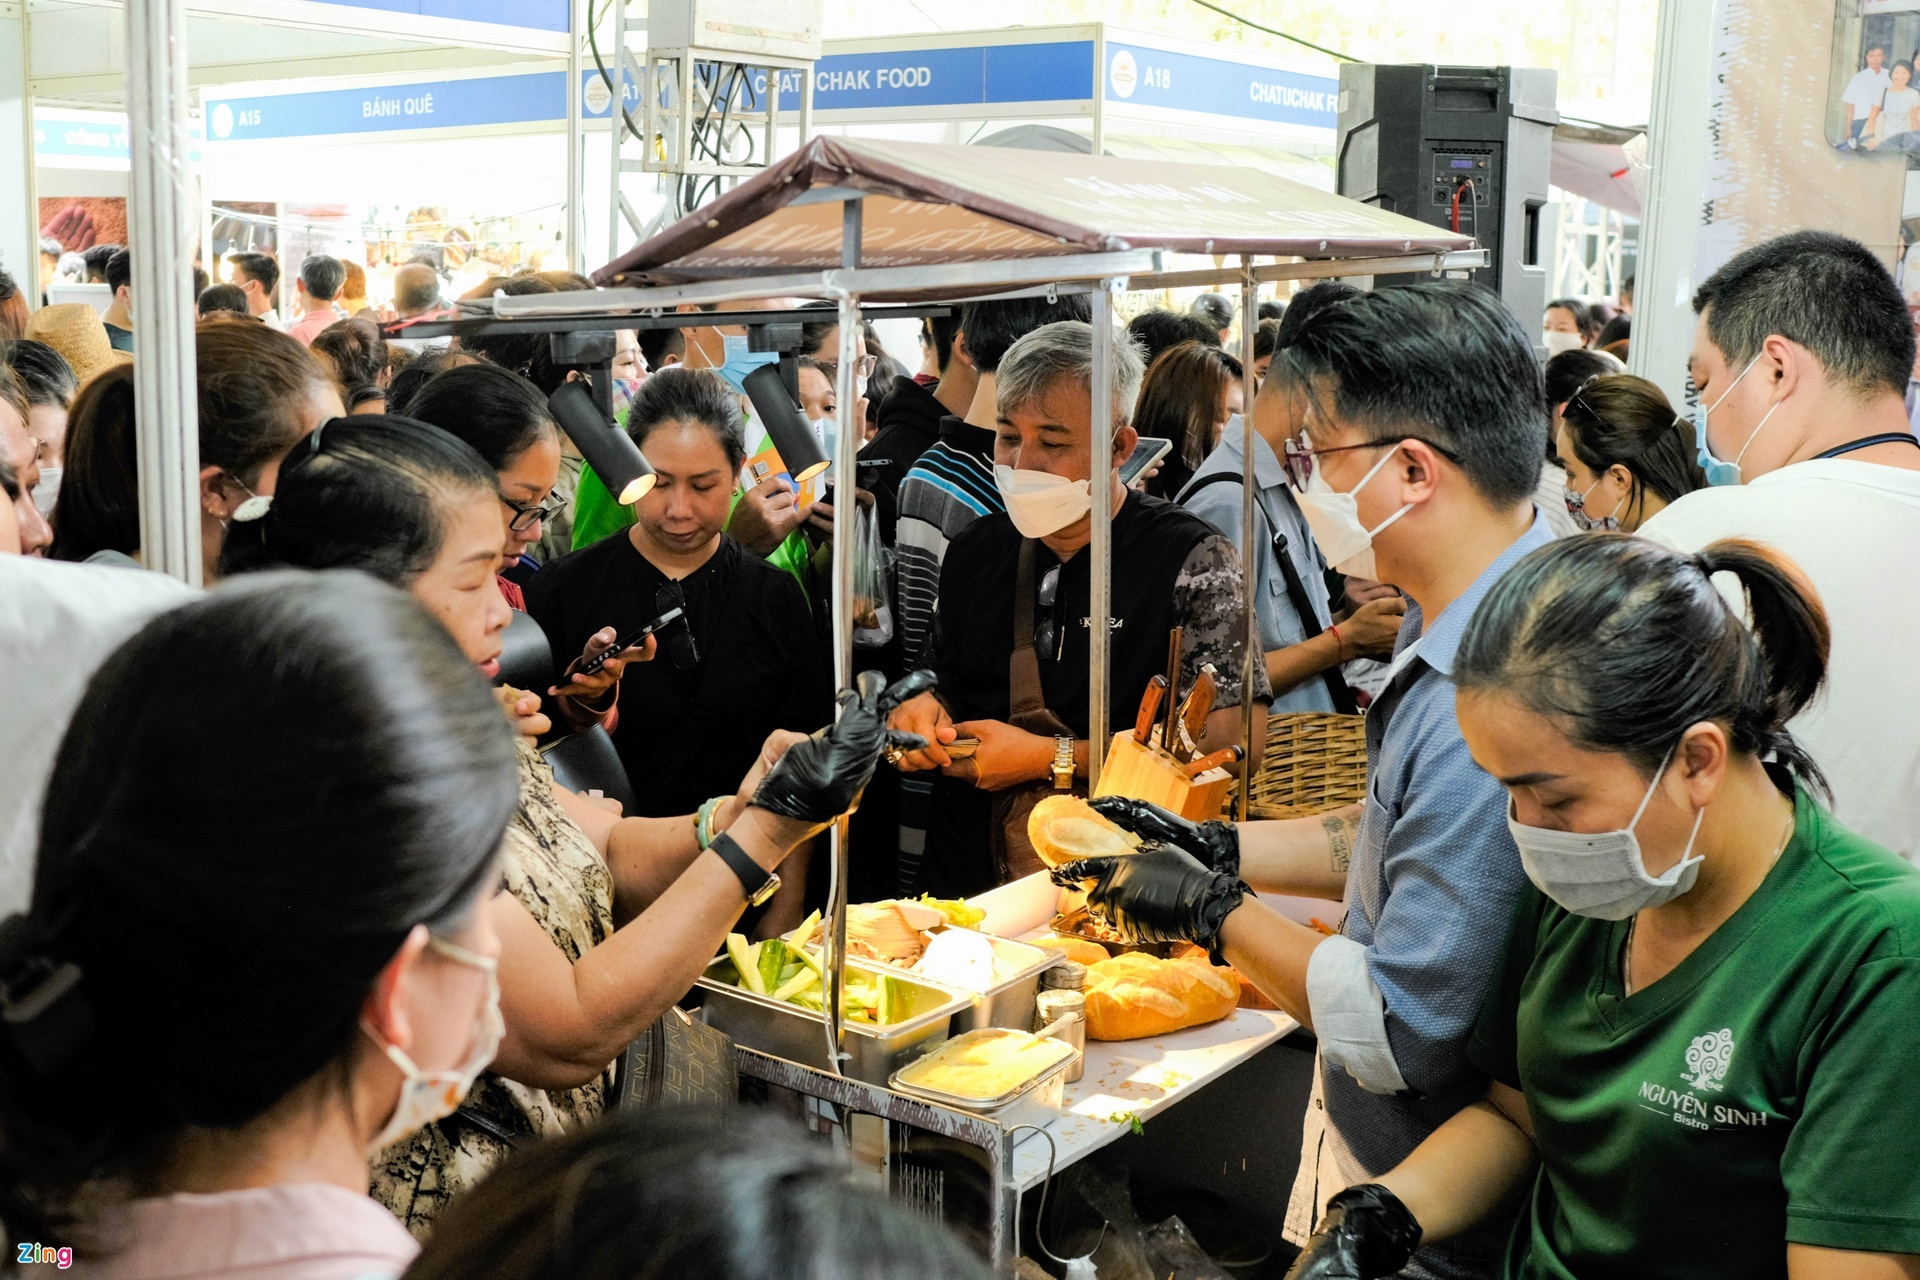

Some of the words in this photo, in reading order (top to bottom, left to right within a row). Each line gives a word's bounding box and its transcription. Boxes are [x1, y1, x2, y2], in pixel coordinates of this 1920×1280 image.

[754, 70, 871, 94] CATCHAK
[876, 66, 931, 89] FOOD
[1144, 66, 1171, 89] A18
[363, 96, 401, 118] BÁNH
[404, 92, 434, 115] QUÊ
[1250, 81, 1325, 112] CHATUCHAK
[238, 110, 261, 126] A15
[1638, 1081, 1708, 1118] NGUYÊN
[1713, 1105, 1768, 1126] SINH
[1673, 1112, 1709, 1131] Bistro
